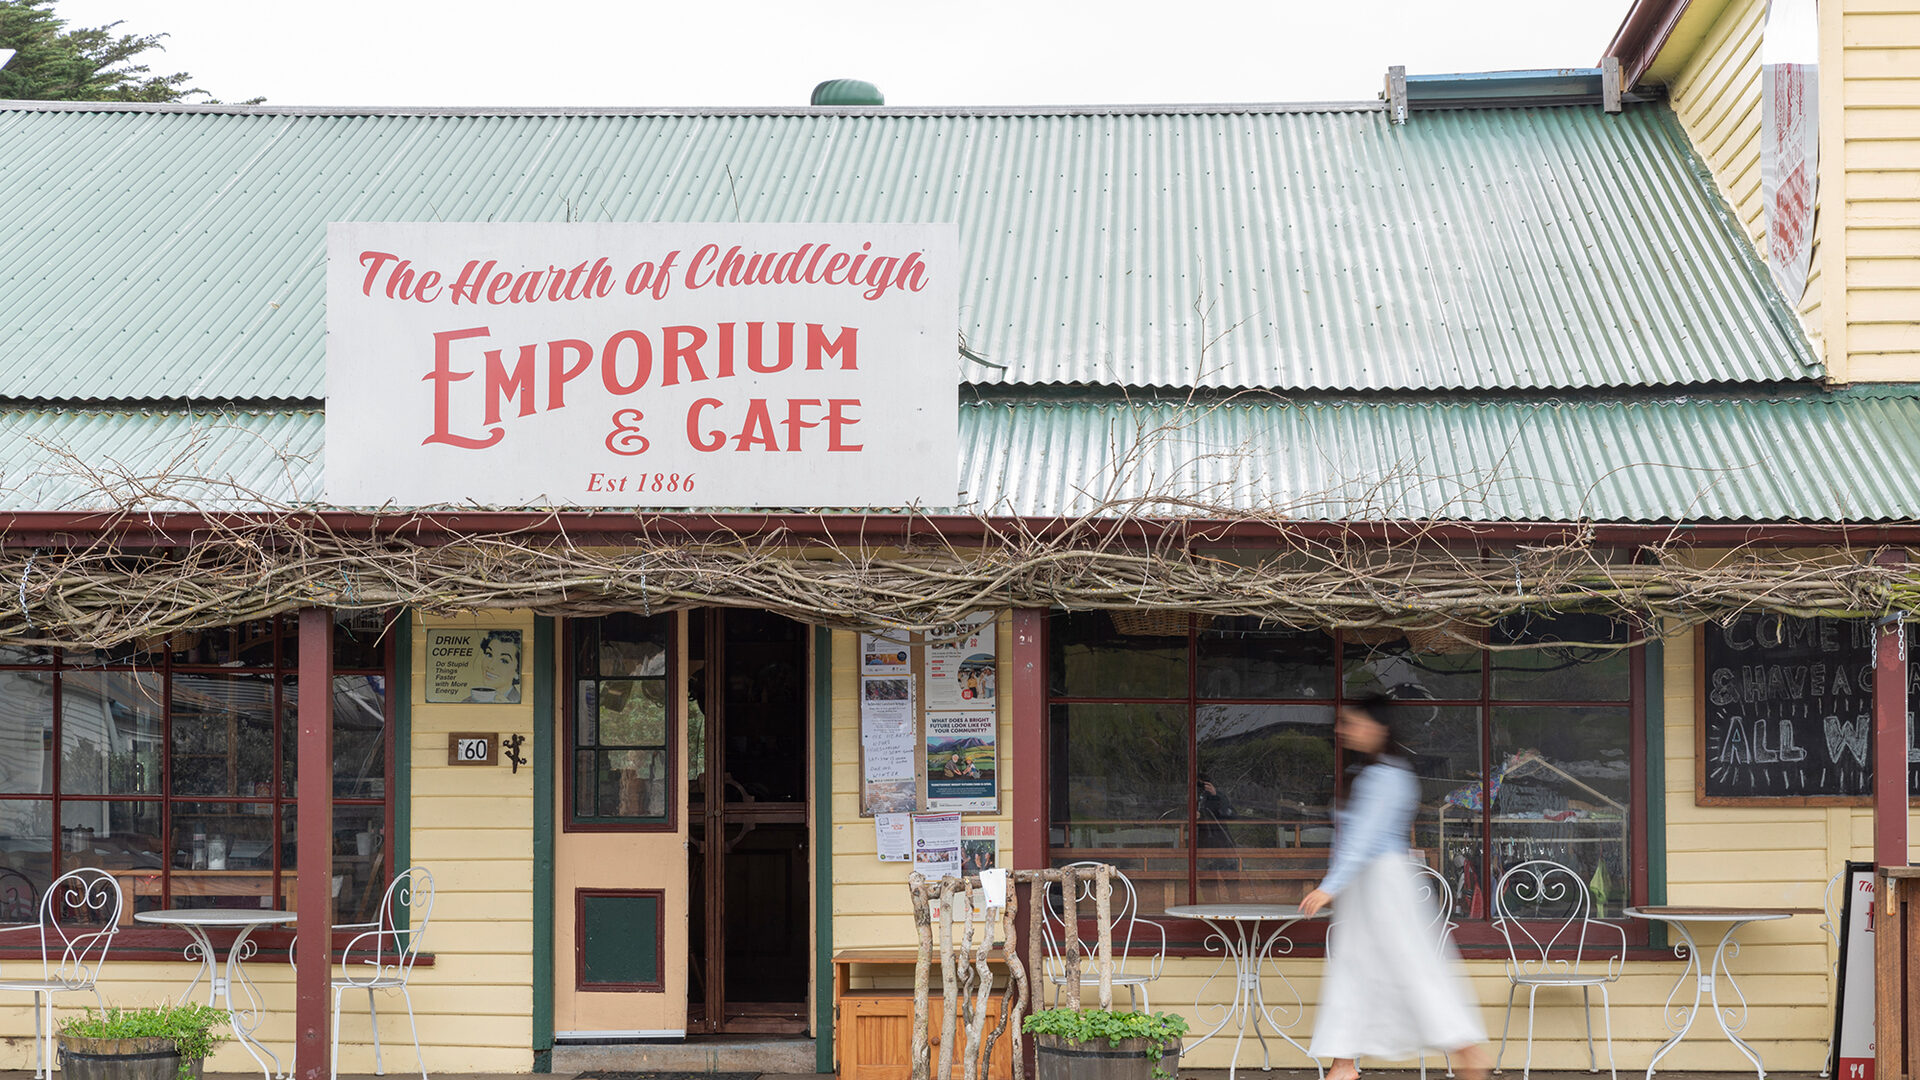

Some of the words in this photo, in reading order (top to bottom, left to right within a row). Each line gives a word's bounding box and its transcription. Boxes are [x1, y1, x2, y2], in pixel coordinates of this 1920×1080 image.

[359, 250, 444, 304] The
[448, 256, 617, 306] Hearth
[624, 250, 682, 301] of
[684, 241, 929, 301] Chudleigh
[421, 321, 859, 449] EMPORIUM
[604, 408, 650, 456] &
[686, 397, 864, 453] CAFE
[586, 472, 627, 492] Est
[636, 472, 695, 493] 1886
[436, 636, 471, 645] DRINK
[1724, 614, 1840, 652] COME
[432, 647, 473, 657] COFFEE
[435, 667, 458, 675] Things
[447, 661, 469, 669] Stupid
[1741, 661, 1826, 704] HAVE
[1831, 664, 1852, 696] A
[465, 740, 487, 759] 60
[1720, 715, 1808, 766] ALL
[967, 825, 981, 836] WITH
[982, 825, 996, 836] JANE
